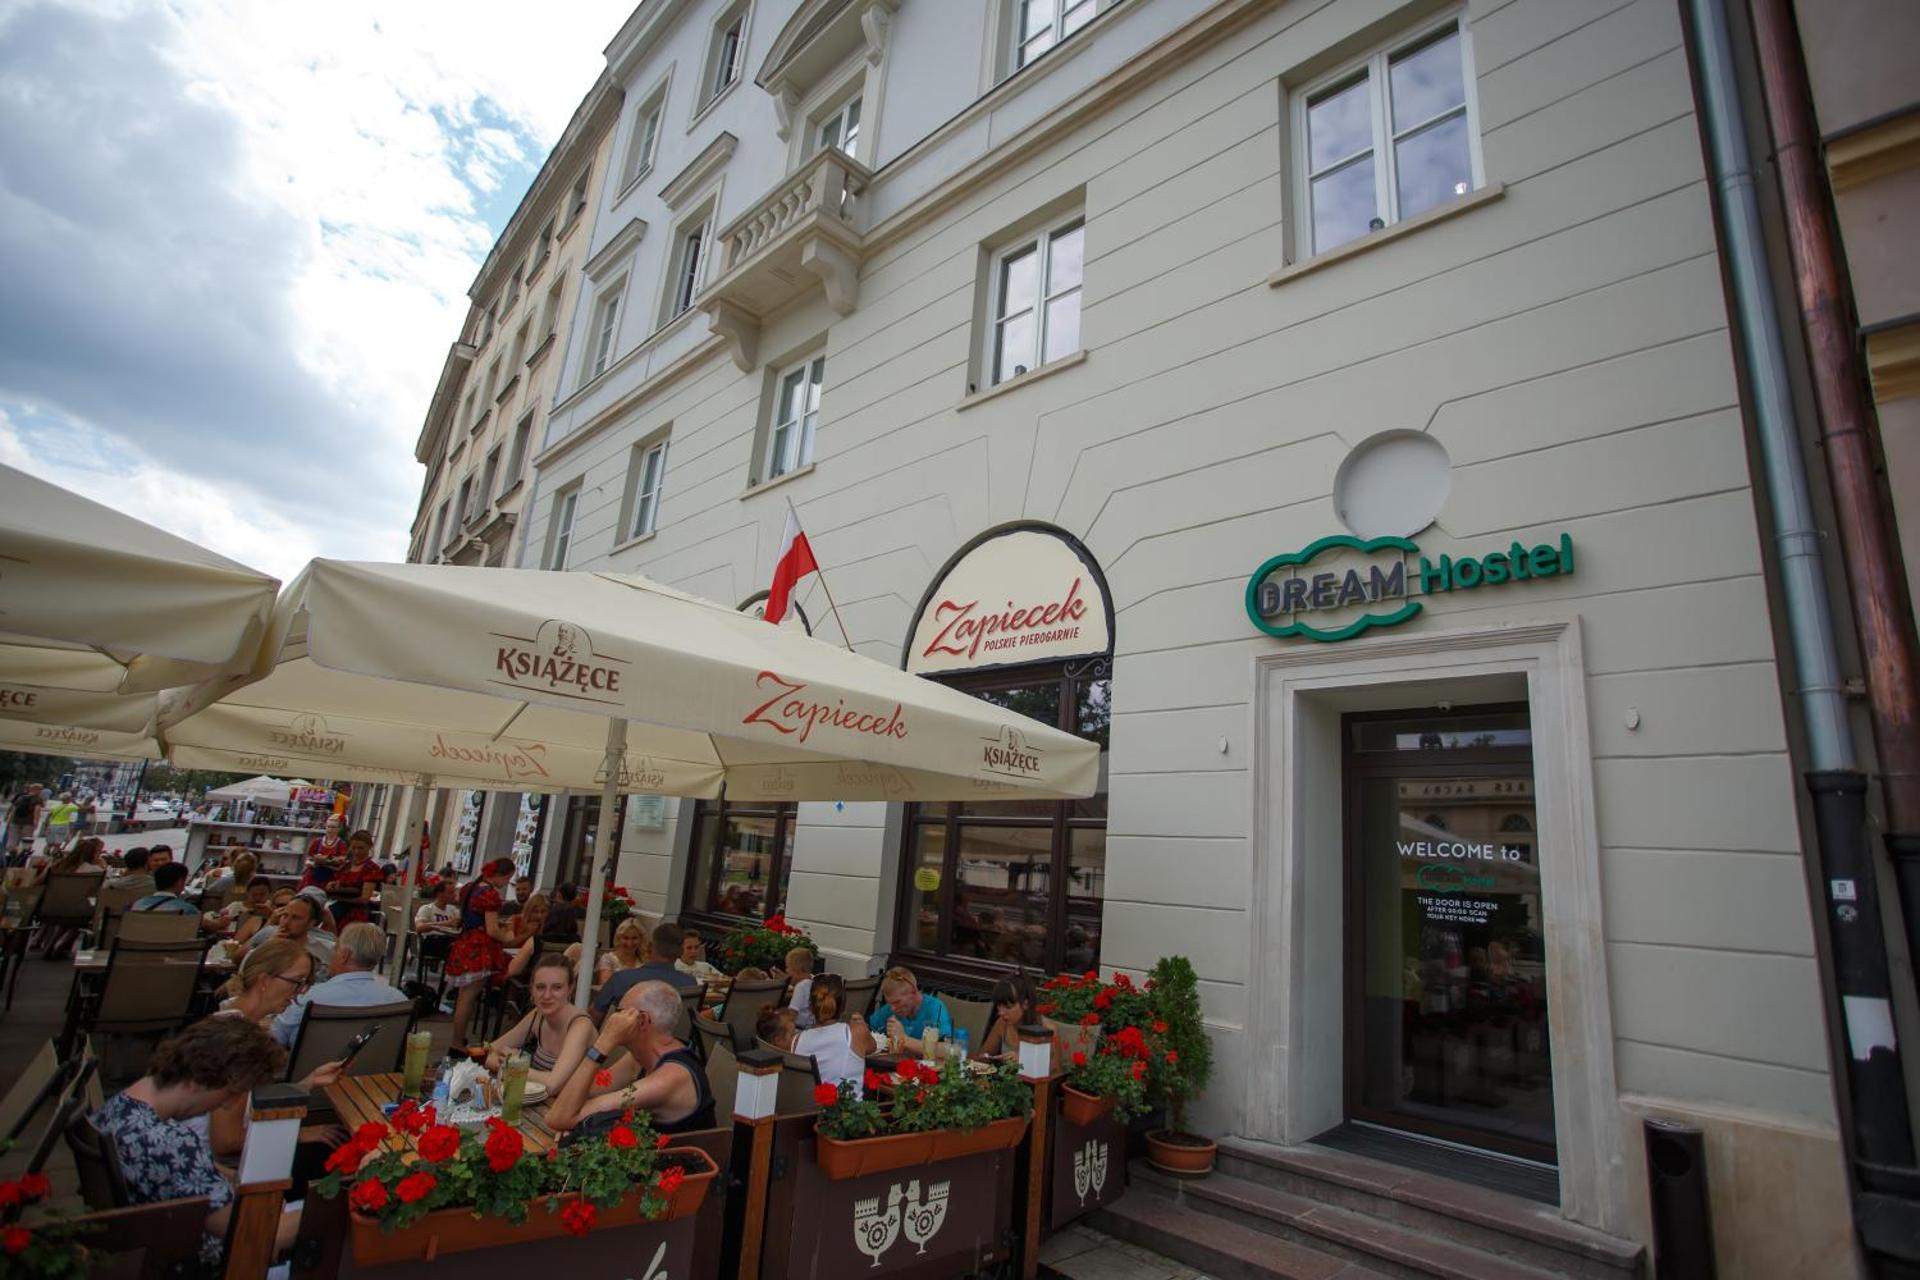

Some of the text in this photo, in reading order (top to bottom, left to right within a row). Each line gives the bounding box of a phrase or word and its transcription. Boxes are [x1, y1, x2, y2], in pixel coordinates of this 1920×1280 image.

[1258, 532, 1575, 616] DREAM Hostel
[923, 577, 1087, 660] Zapiecek
[984, 627, 1079, 651] POLSKIE PIEROGARNIE
[497, 648, 620, 692] KSIĄŻĘCE
[743, 671, 908, 744] Zapiecek
[984, 746, 1040, 773] KSIĄŻĘCE
[1396, 841, 1521, 861] WELCOME to
[1417, 896, 1499, 910] THE DOOR IS OPEN
